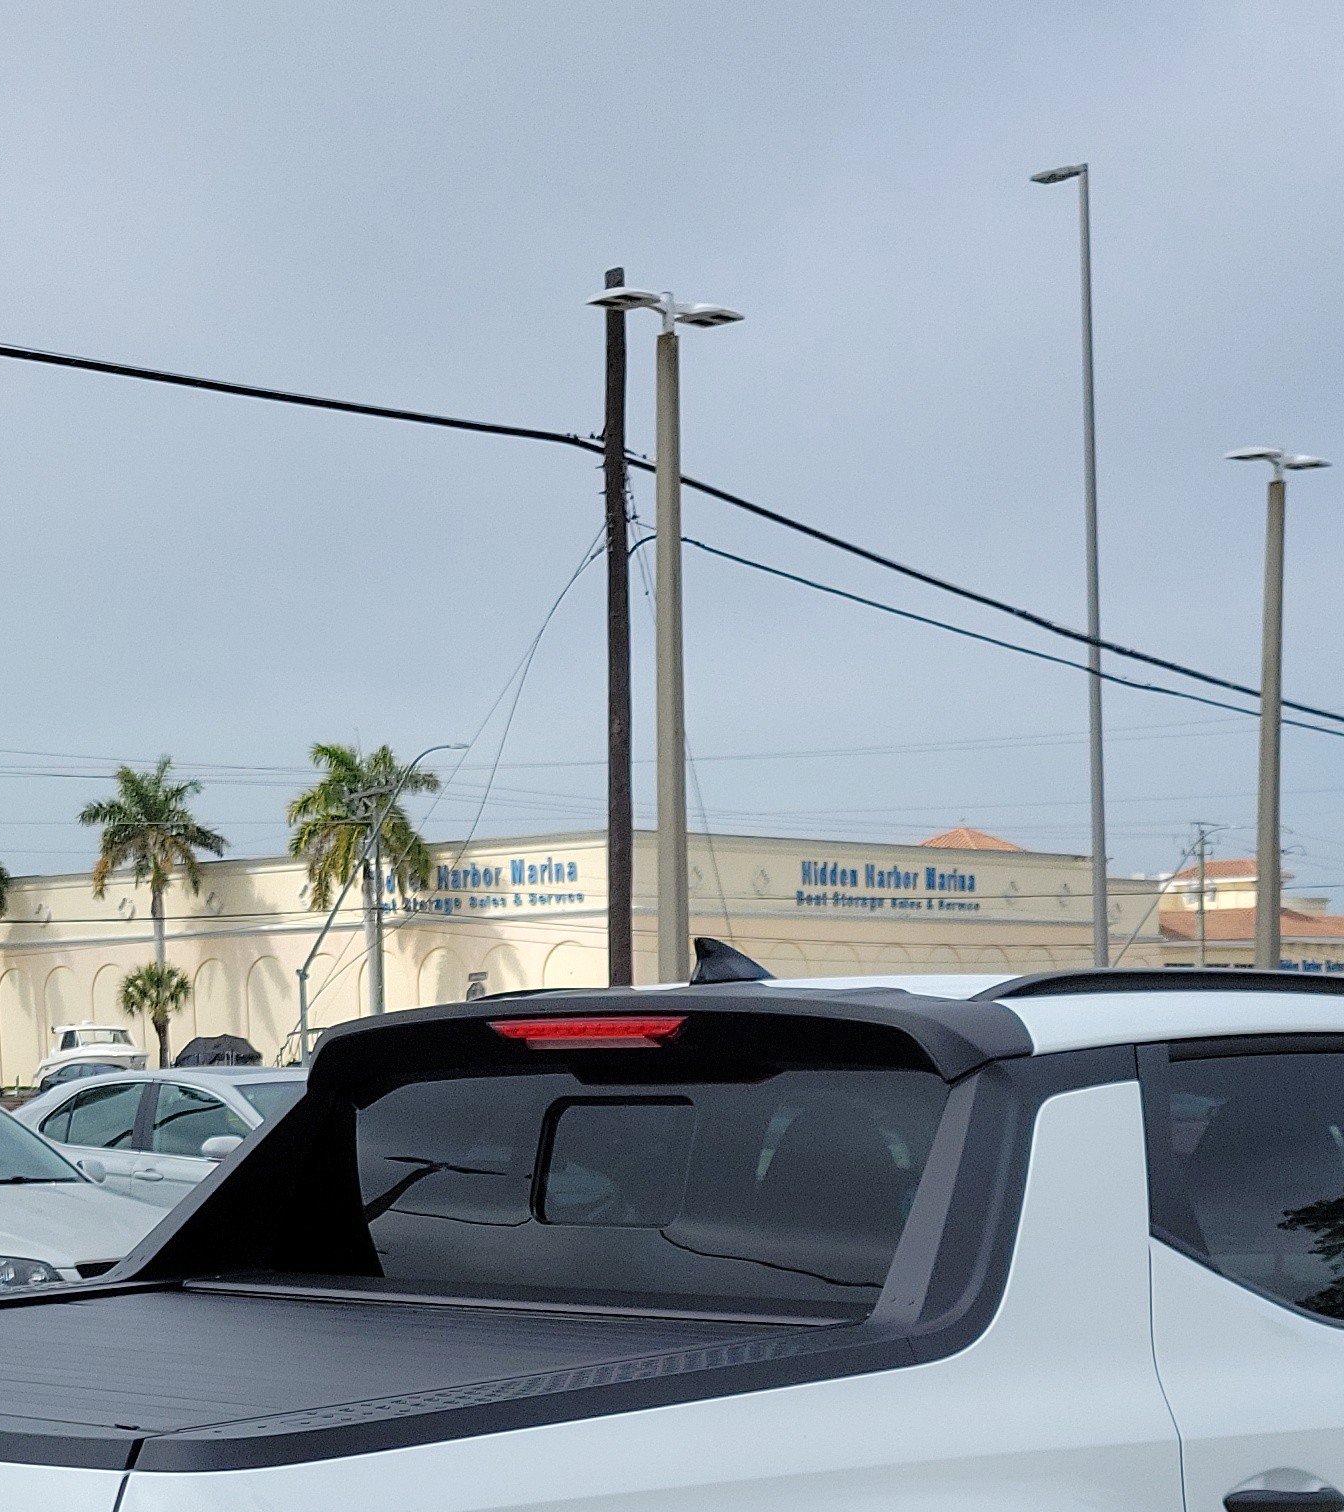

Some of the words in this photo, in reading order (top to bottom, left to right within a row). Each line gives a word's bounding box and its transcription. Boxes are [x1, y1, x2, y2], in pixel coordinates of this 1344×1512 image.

[437, 863, 503, 890] Harbor
[510, 857, 578, 886] Marina
[801, 860, 858, 888] Hidden
[865, 863, 919, 891] Harbor
[925, 866, 976, 893] Marina
[469, 895, 507, 909] Sales
[513, 892, 523, 907] &
[528, 891, 585, 906] Service
[796, 889, 828, 907] Boat
